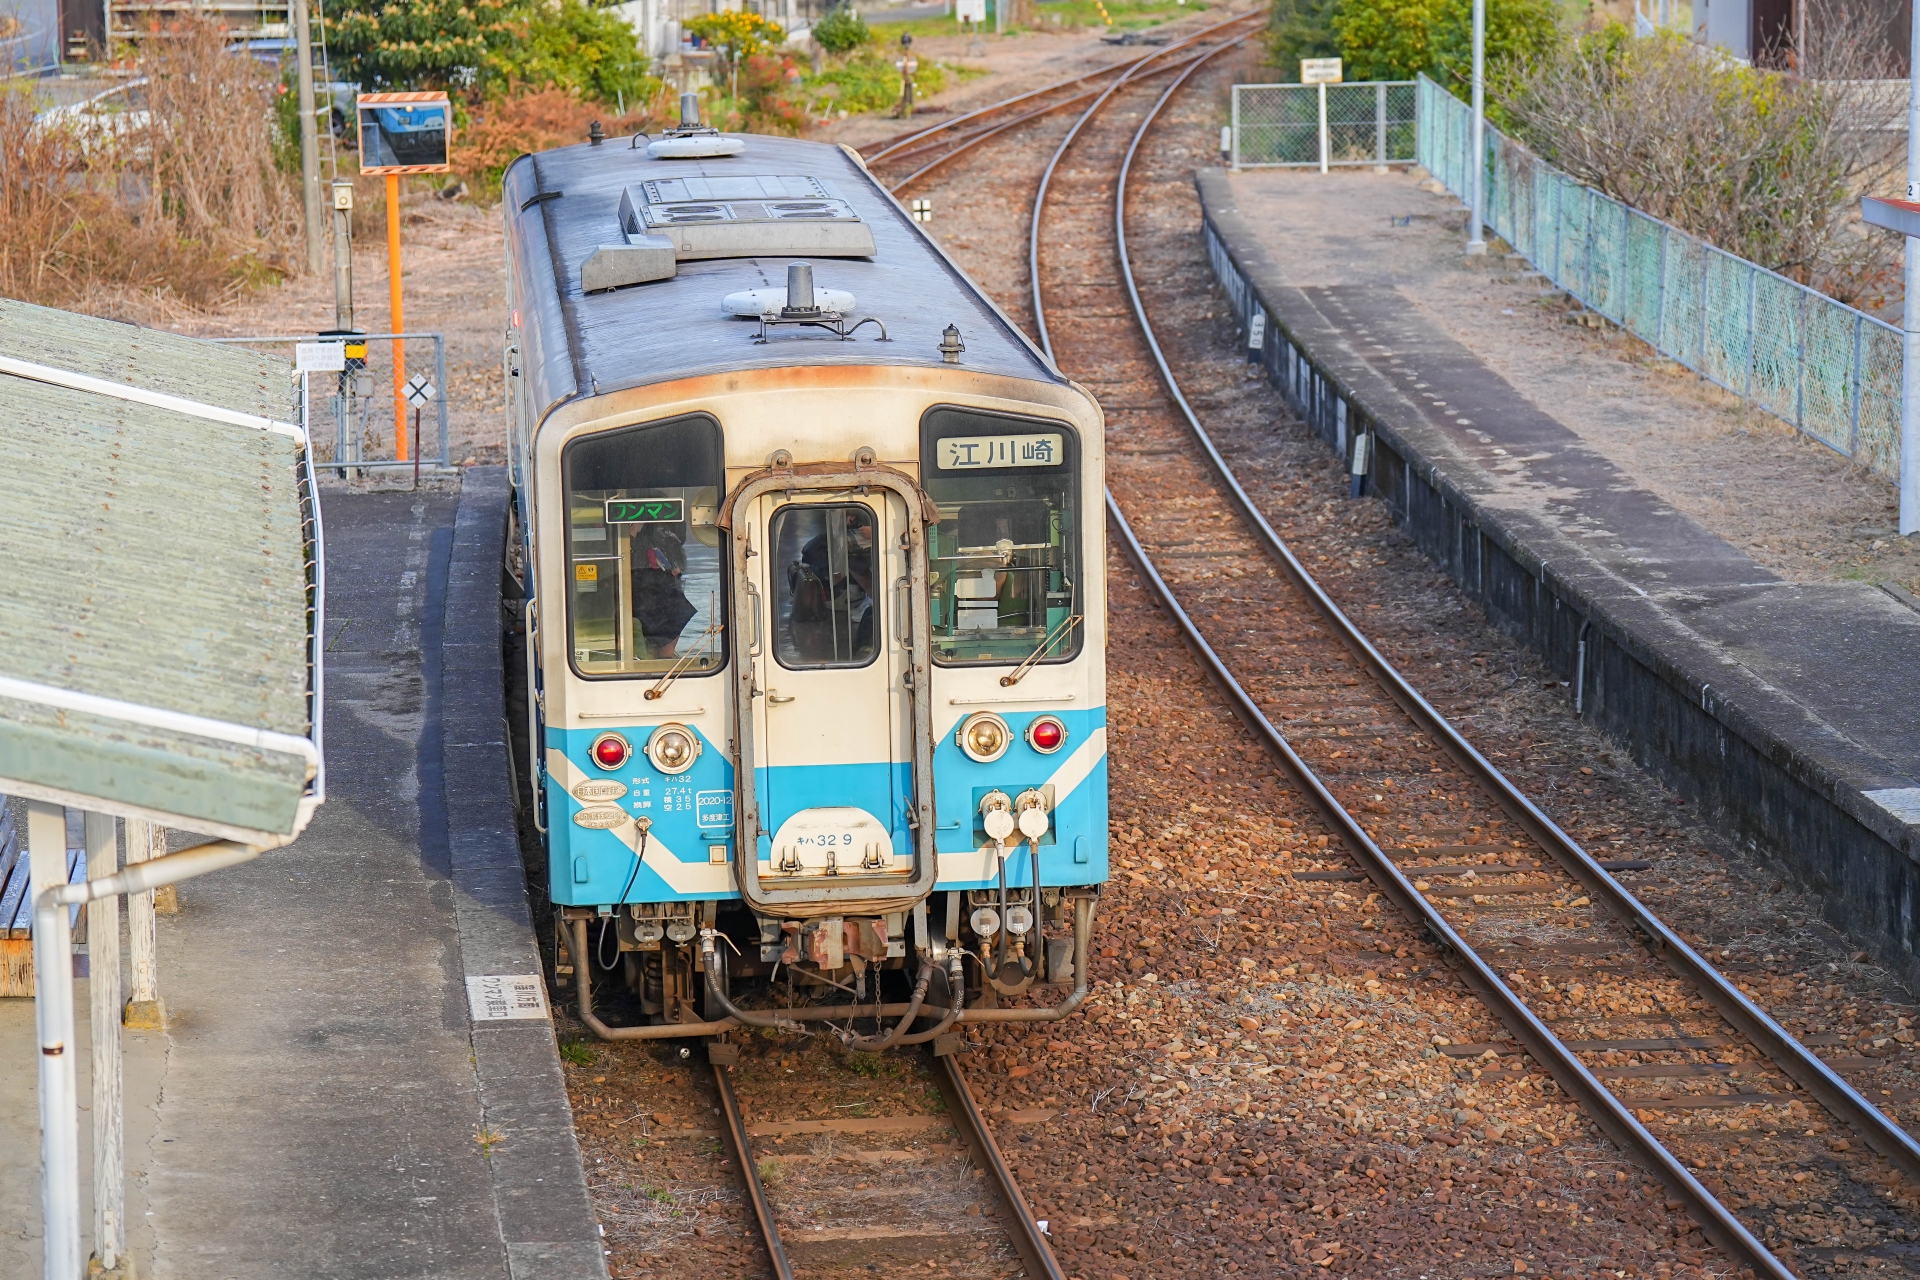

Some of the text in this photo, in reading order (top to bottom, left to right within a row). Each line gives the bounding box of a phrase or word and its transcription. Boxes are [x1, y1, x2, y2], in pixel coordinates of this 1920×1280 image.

[1252, 321, 1264, 346] 350
[949, 438, 1054, 467] 江川崎
[610, 502, 680, 521] ワンマン
[632, 775, 692, 785] 形式 キハ32
[698, 796, 732, 806] 2020-12
[797, 834, 852, 846] キハ32 9
